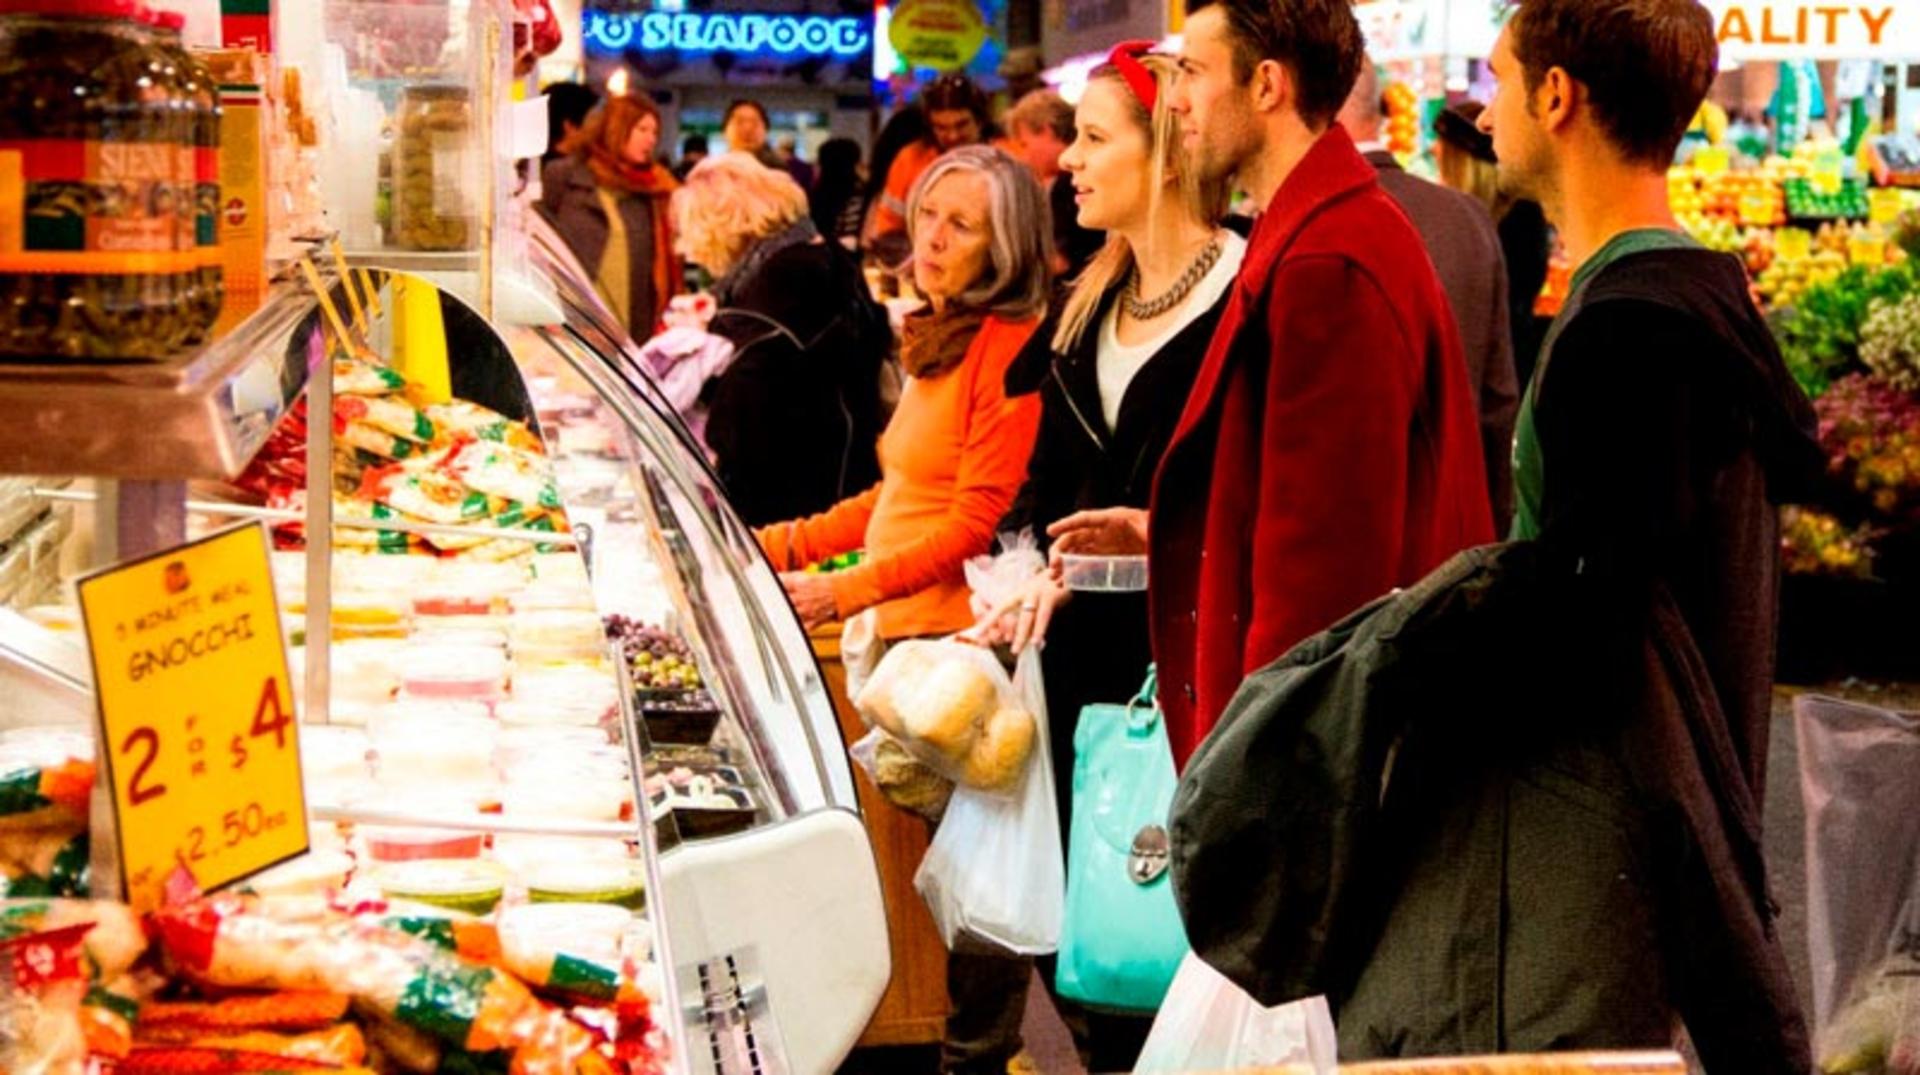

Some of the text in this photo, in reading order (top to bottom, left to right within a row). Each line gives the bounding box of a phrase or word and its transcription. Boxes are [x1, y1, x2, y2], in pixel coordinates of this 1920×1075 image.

[642, 13, 868, 53] SEAFOOD
[129, 613, 254, 682] GNOCCHI
[121, 726, 167, 807] 2
